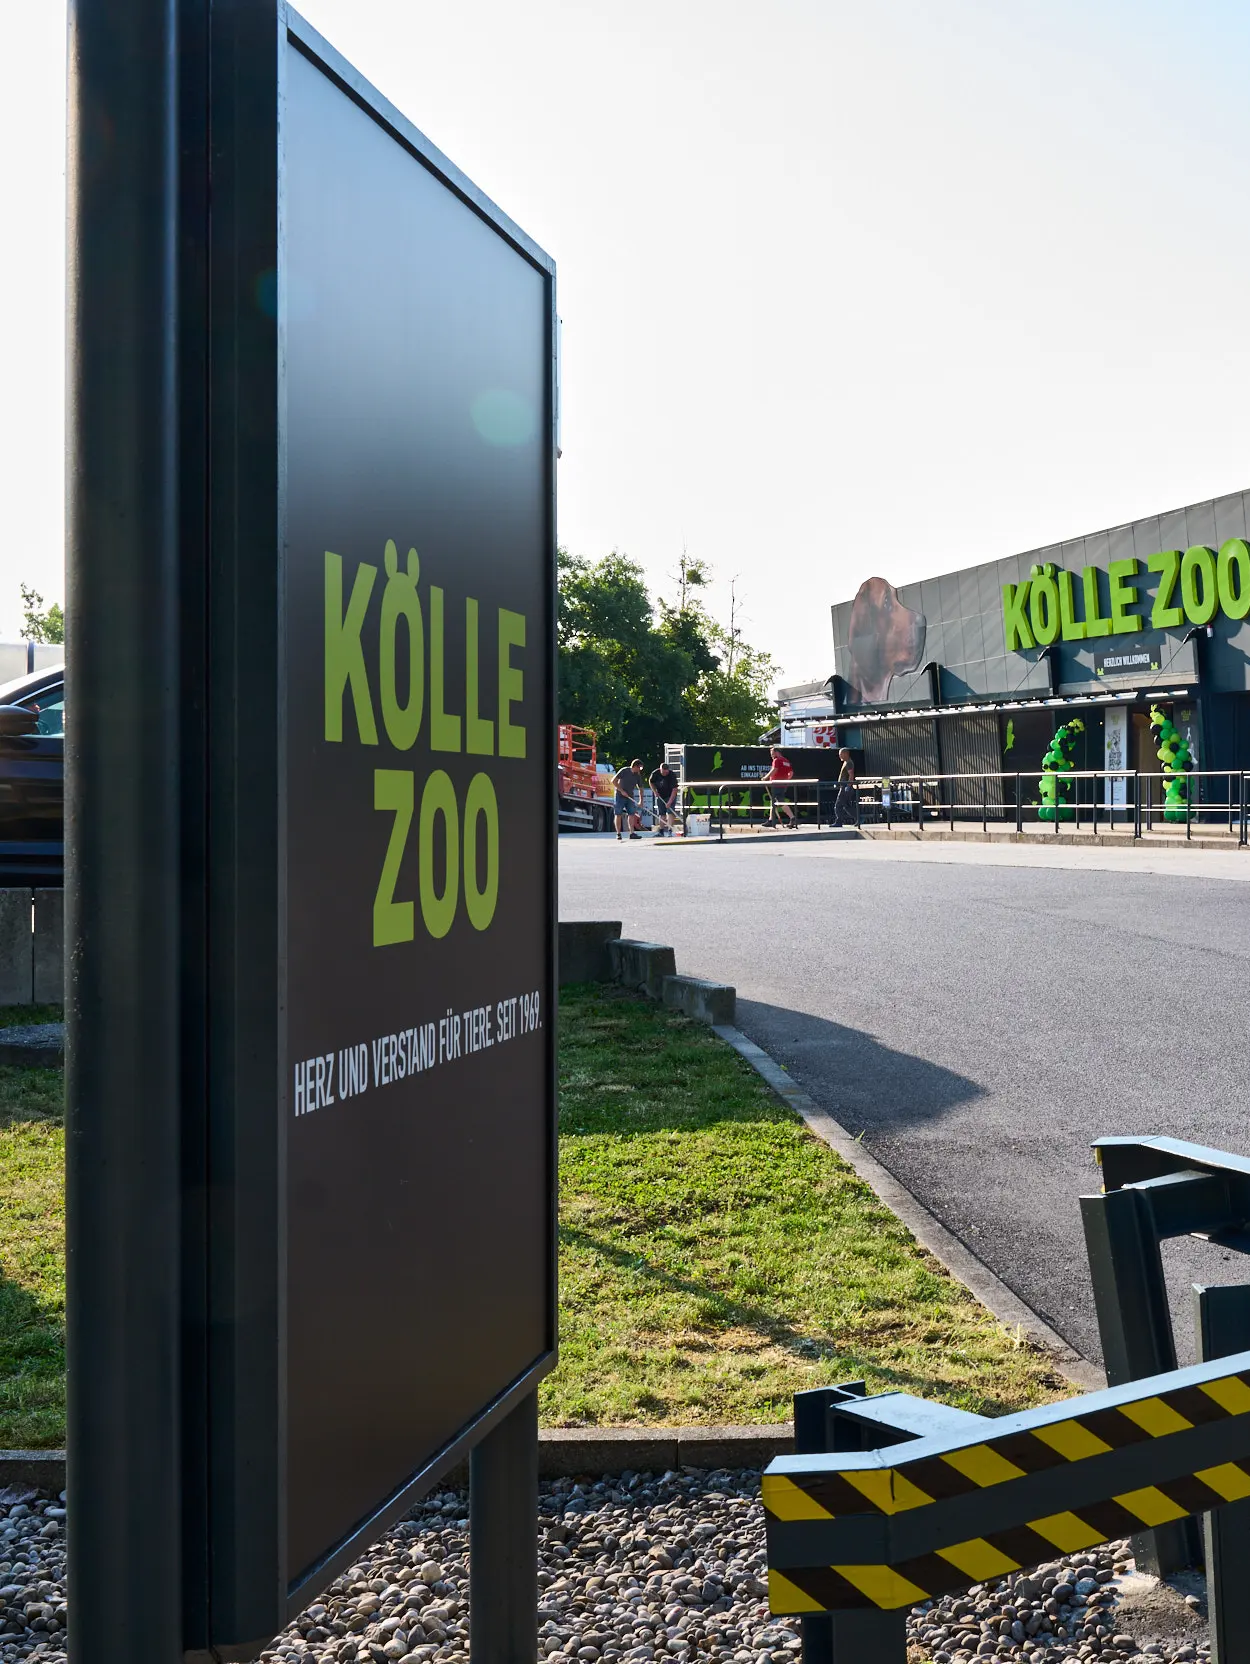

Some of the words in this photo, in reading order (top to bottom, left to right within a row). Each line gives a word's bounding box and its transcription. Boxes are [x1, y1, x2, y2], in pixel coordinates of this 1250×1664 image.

[325, 539, 526, 758] KÖLLE
[1002, 558, 1143, 651] KÖLLE
[373, 769, 499, 947] ZOO
[295, 1053, 334, 1117] HERZ
[339, 1043, 368, 1100] UND
[372, 1022, 436, 1087] VERSTAND
[439, 1008, 461, 1064] FÜR
[463, 1004, 494, 1054] TIERE.
[497, 998, 517, 1043] SEIT
[519, 991, 542, 1034] 1969.
